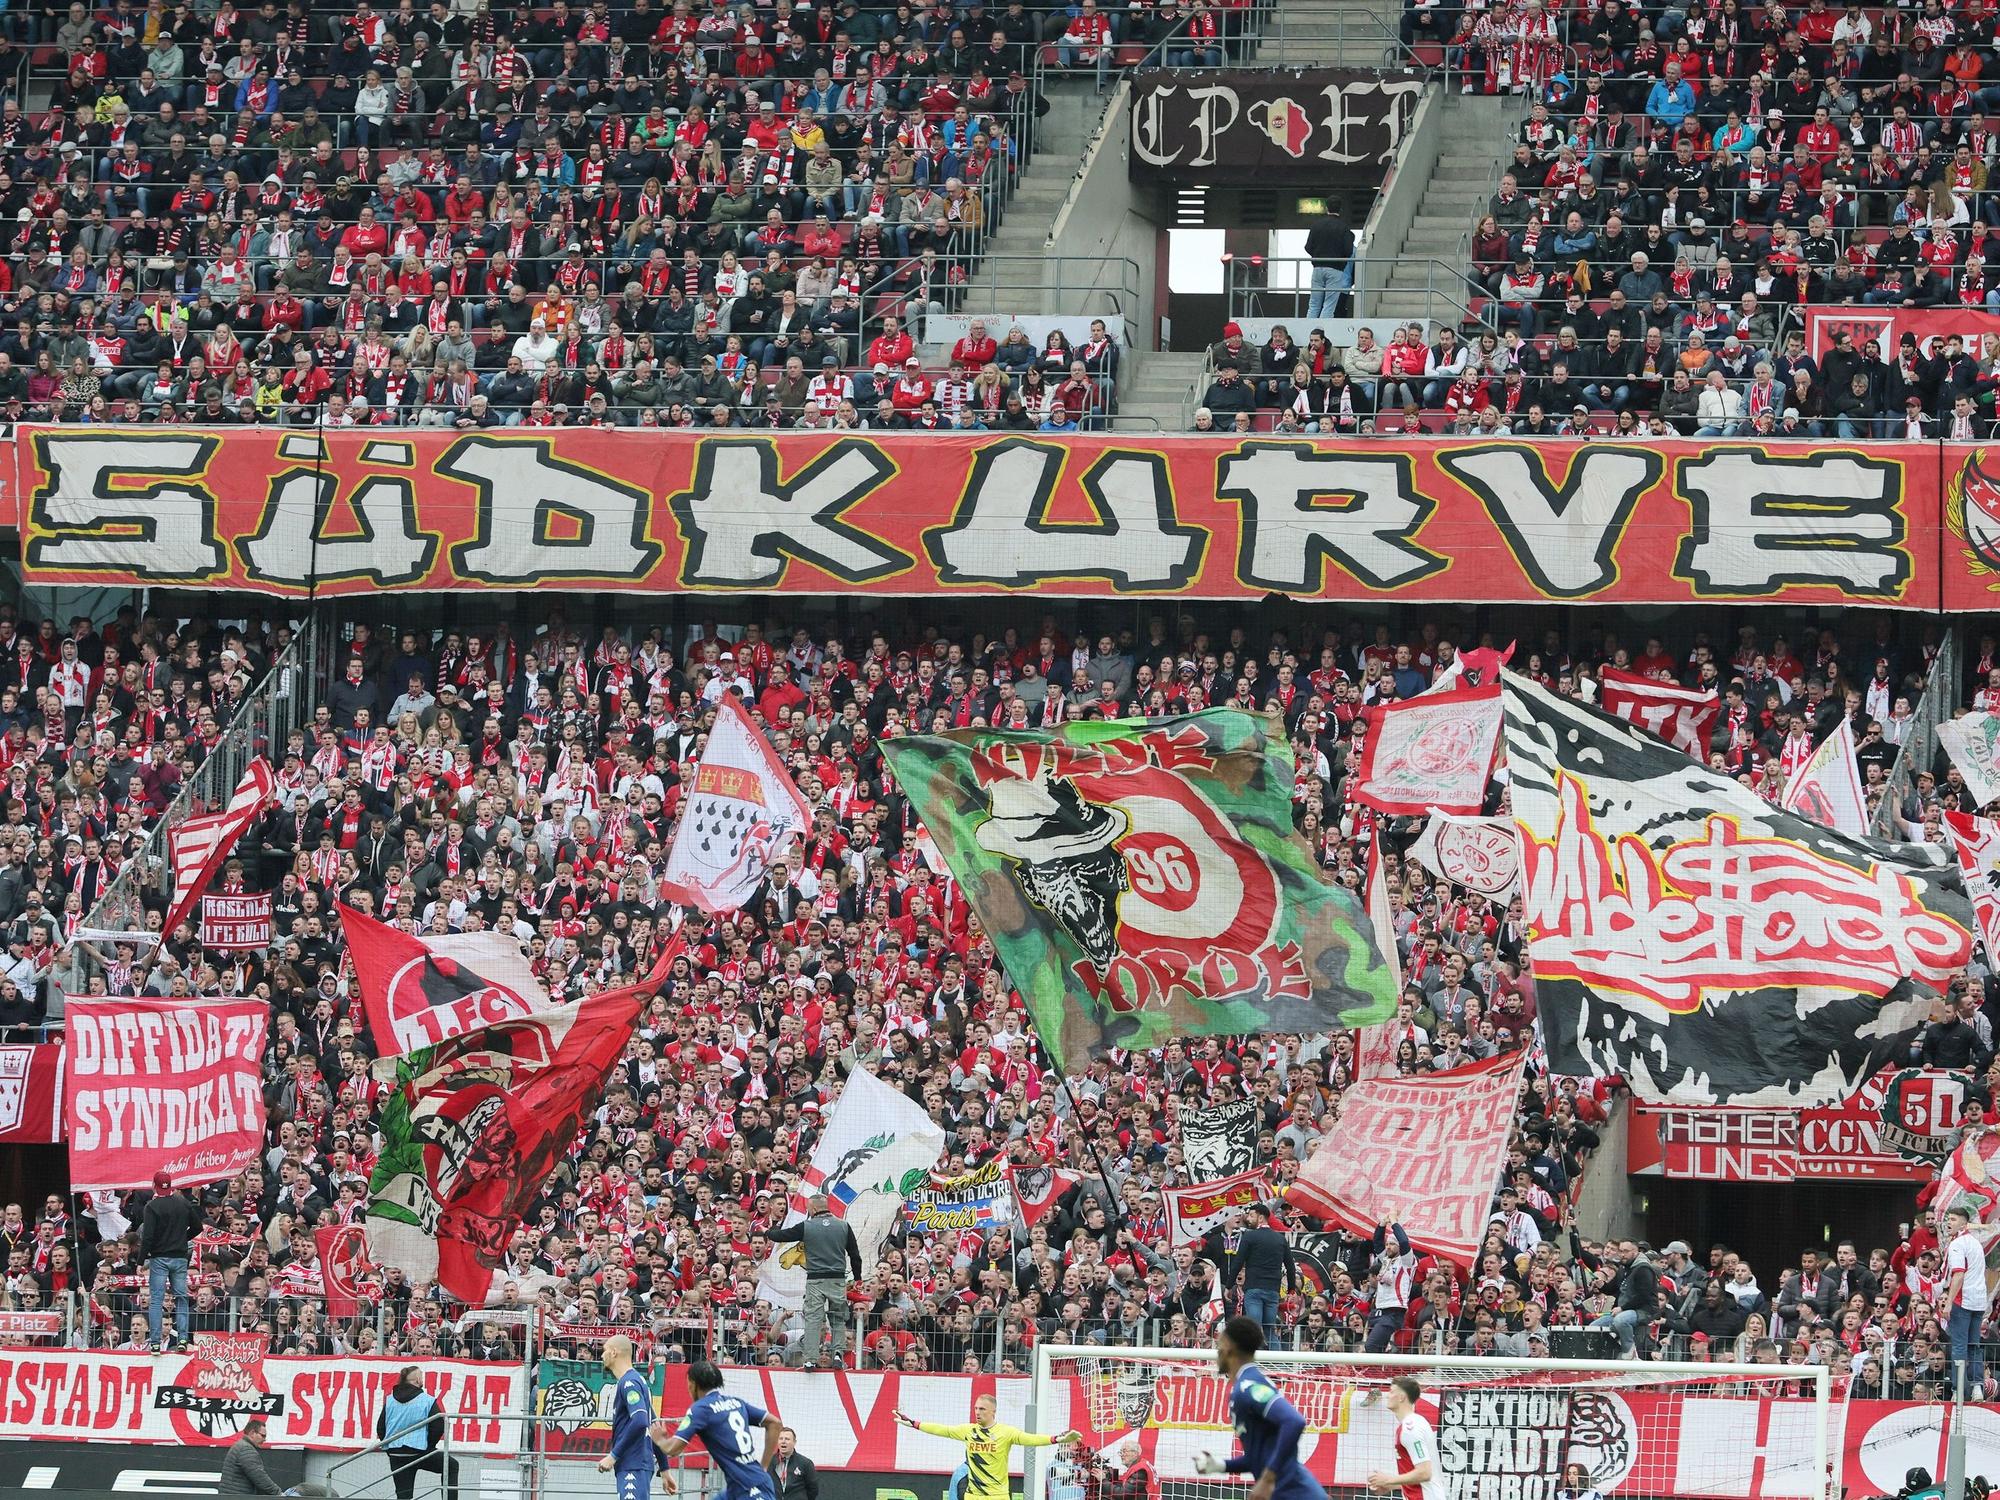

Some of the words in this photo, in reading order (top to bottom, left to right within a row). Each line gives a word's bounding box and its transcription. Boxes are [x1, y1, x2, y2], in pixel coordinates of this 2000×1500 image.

[98, 346, 121, 355] REWE
[1124, 844, 1195, 896] 96
[415, 994, 508, 1044] 1.FC
[72, 1009, 265, 1076] DIFFIDATI
[74, 1071, 262, 1152] SYNDIKAT
[1218, 1098, 1258, 1121] HORDE
[1666, 1111, 1796, 1146] HÖHER
[1667, 1147, 1795, 1181] JUNGS
[910, 1202, 978, 1231] Paris
[9, 1315, 49, 1331] Platz
[220, 1397, 278, 1414] 2007
[286, 1370, 512, 1446] SYNKAT
[1443, 1390, 1568, 1428] SEKTION
[728, 1409, 753, 1455] 8
[968, 1441, 997, 1454] REWE
[1441, 1427, 1567, 1474] STADT
